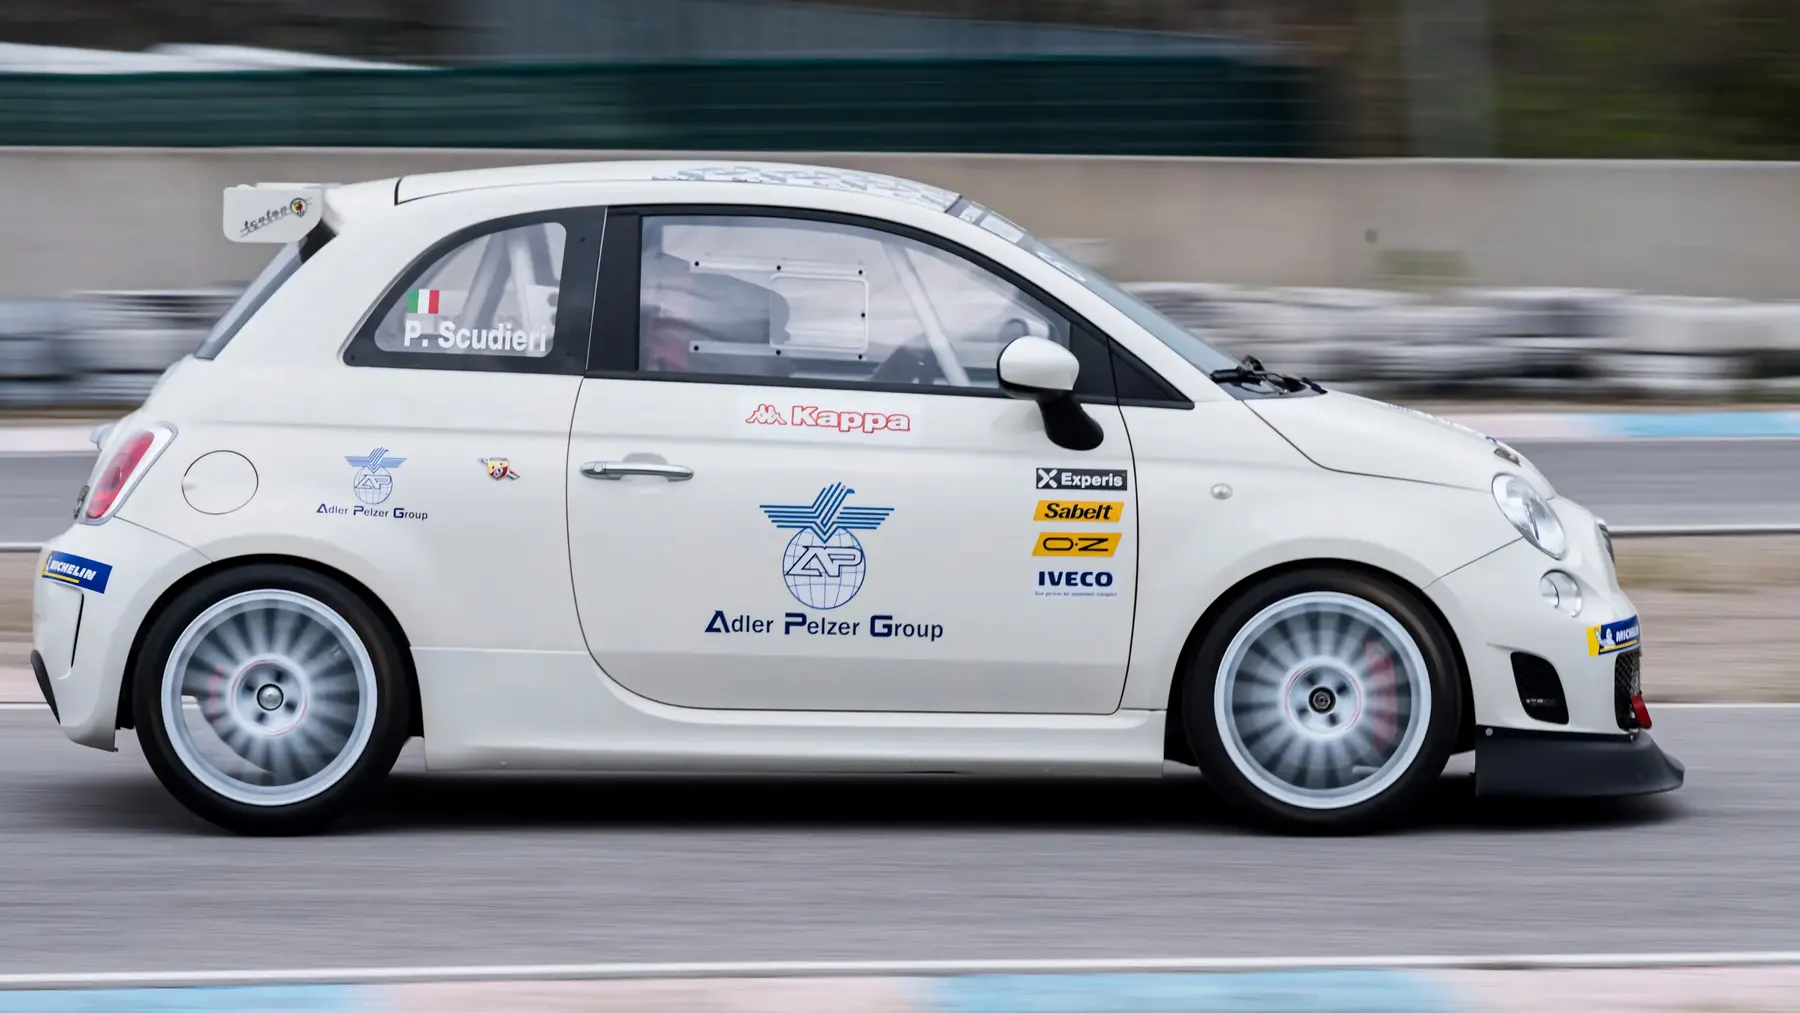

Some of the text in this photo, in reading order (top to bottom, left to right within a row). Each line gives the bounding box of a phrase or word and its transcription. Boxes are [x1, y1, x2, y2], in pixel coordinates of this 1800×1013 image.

[404, 320, 547, 352] P. Scudieri
[791, 405, 911, 434] Kappa
[1061, 471, 1123, 489] Experis
[316, 503, 428, 521] Adler Pelzer Group
[1044, 502, 1113, 520] Sabelt
[49, 559, 97, 581] MICHELIN
[1038, 571, 1113, 587] IVECO
[704, 610, 944, 642] Adler Pelzer Group
